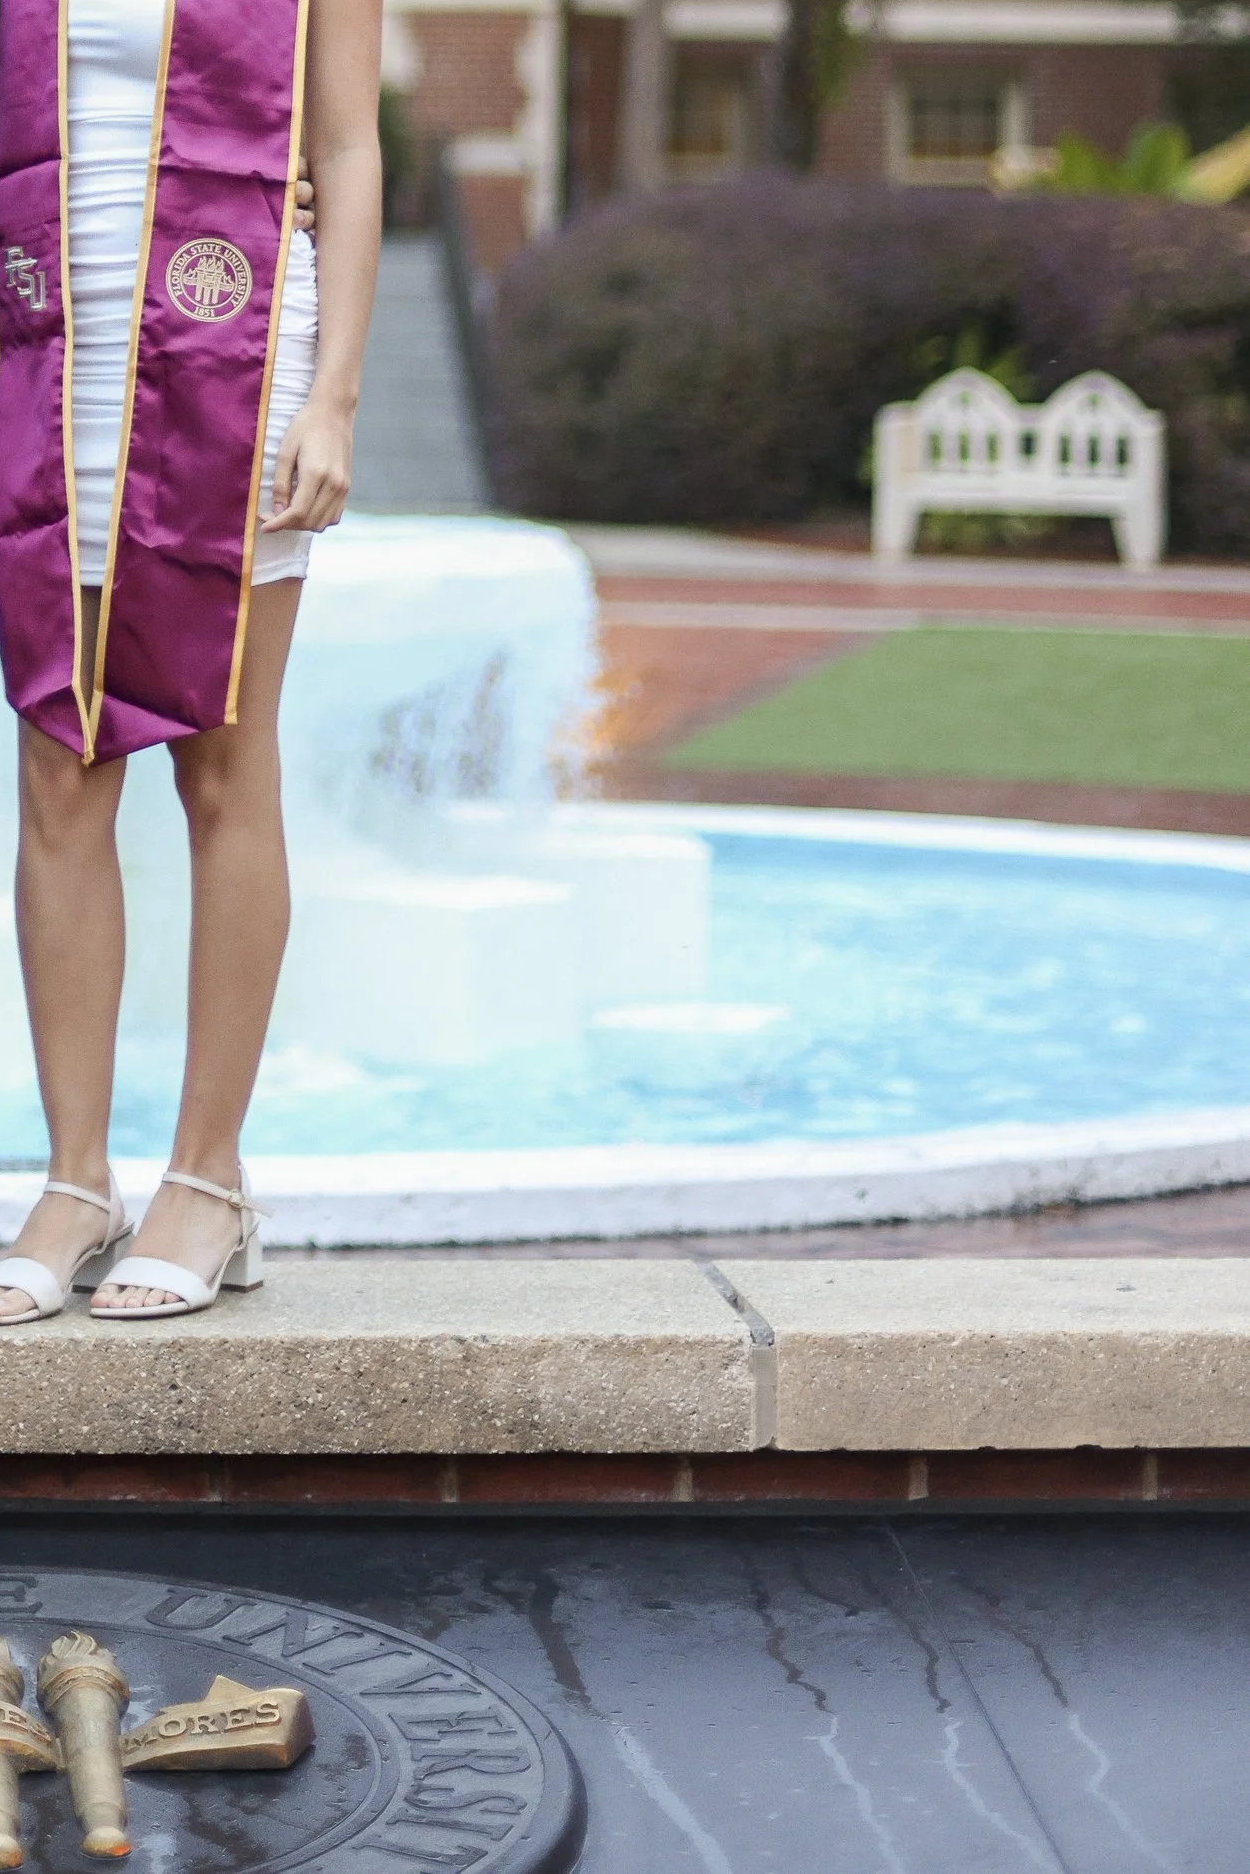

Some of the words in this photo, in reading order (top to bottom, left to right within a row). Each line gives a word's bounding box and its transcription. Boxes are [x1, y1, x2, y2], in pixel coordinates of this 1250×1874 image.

[4, 245, 47, 312] FSU
[171, 252, 191, 297] FLORIDA
[190, 243, 222, 255] STATE
[224, 248, 247, 308] UNIVERSITY
[193, 307, 216, 318] 1851
[119, 1700, 281, 1755] MORES
[146, 1588, 532, 1874] UNIVERSIT
